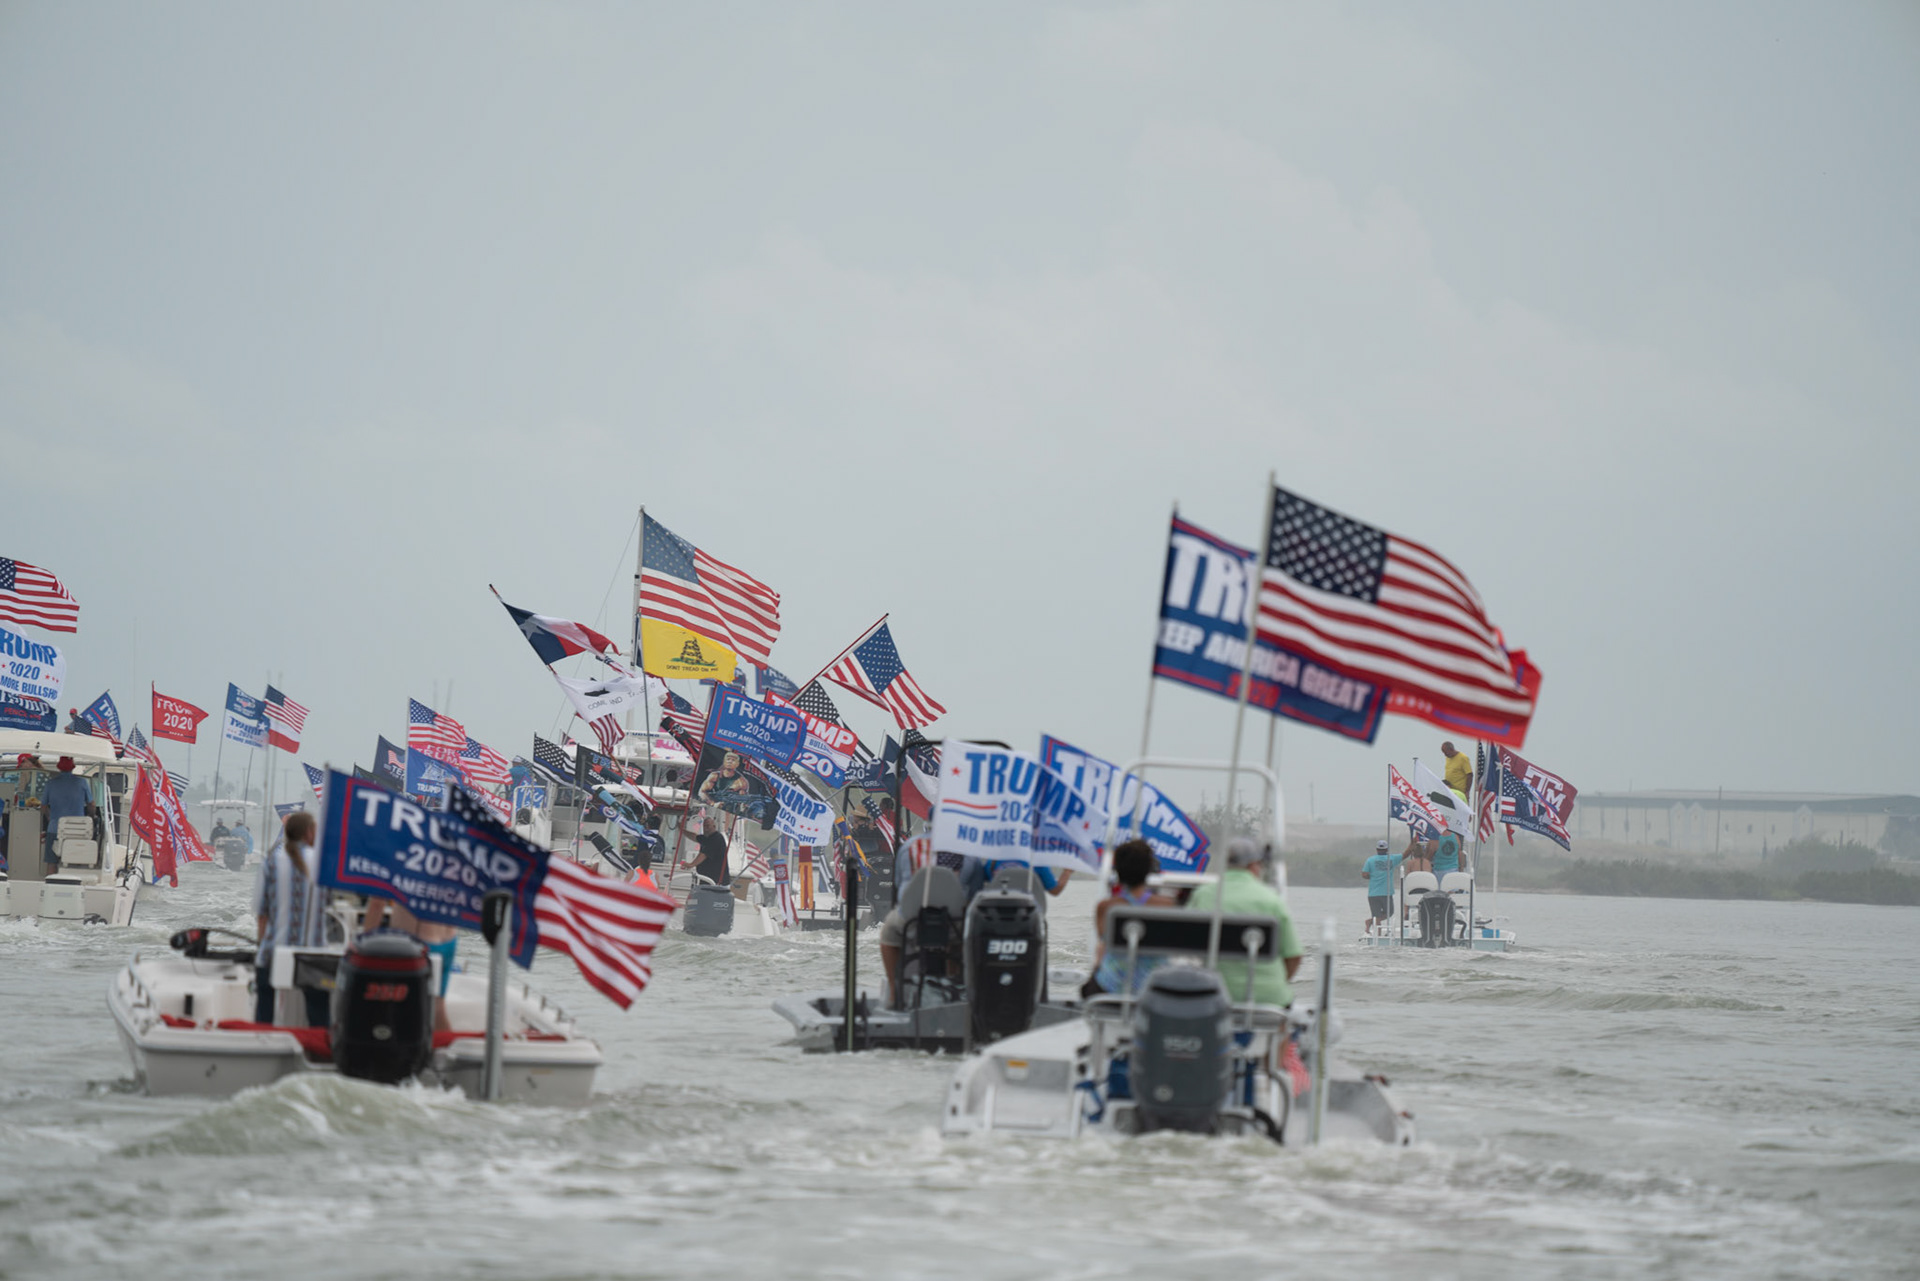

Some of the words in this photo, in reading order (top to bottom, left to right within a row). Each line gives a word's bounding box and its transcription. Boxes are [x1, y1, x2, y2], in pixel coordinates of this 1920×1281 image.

[0, 627, 58, 668] RUMP
[9, 660, 41, 681] 2020
[682, 665, 699, 673] TREAD
[163, 712, 193, 730] 2020
[726, 696, 798, 735] TRUMP
[718, 729, 738, 741] KEEP
[426, 744, 457, 758] FOR
[416, 782, 442, 794] TRUMP
[965, 751, 1087, 827] TRUMP
[957, 824, 979, 843] NO
[981, 830, 1017, 847] MORE
[1147, 837, 1193, 865] GREA
[391, 876, 467, 908] AMERICA
[713, 901, 729, 909] 250
[987, 940, 1028, 955] 300
